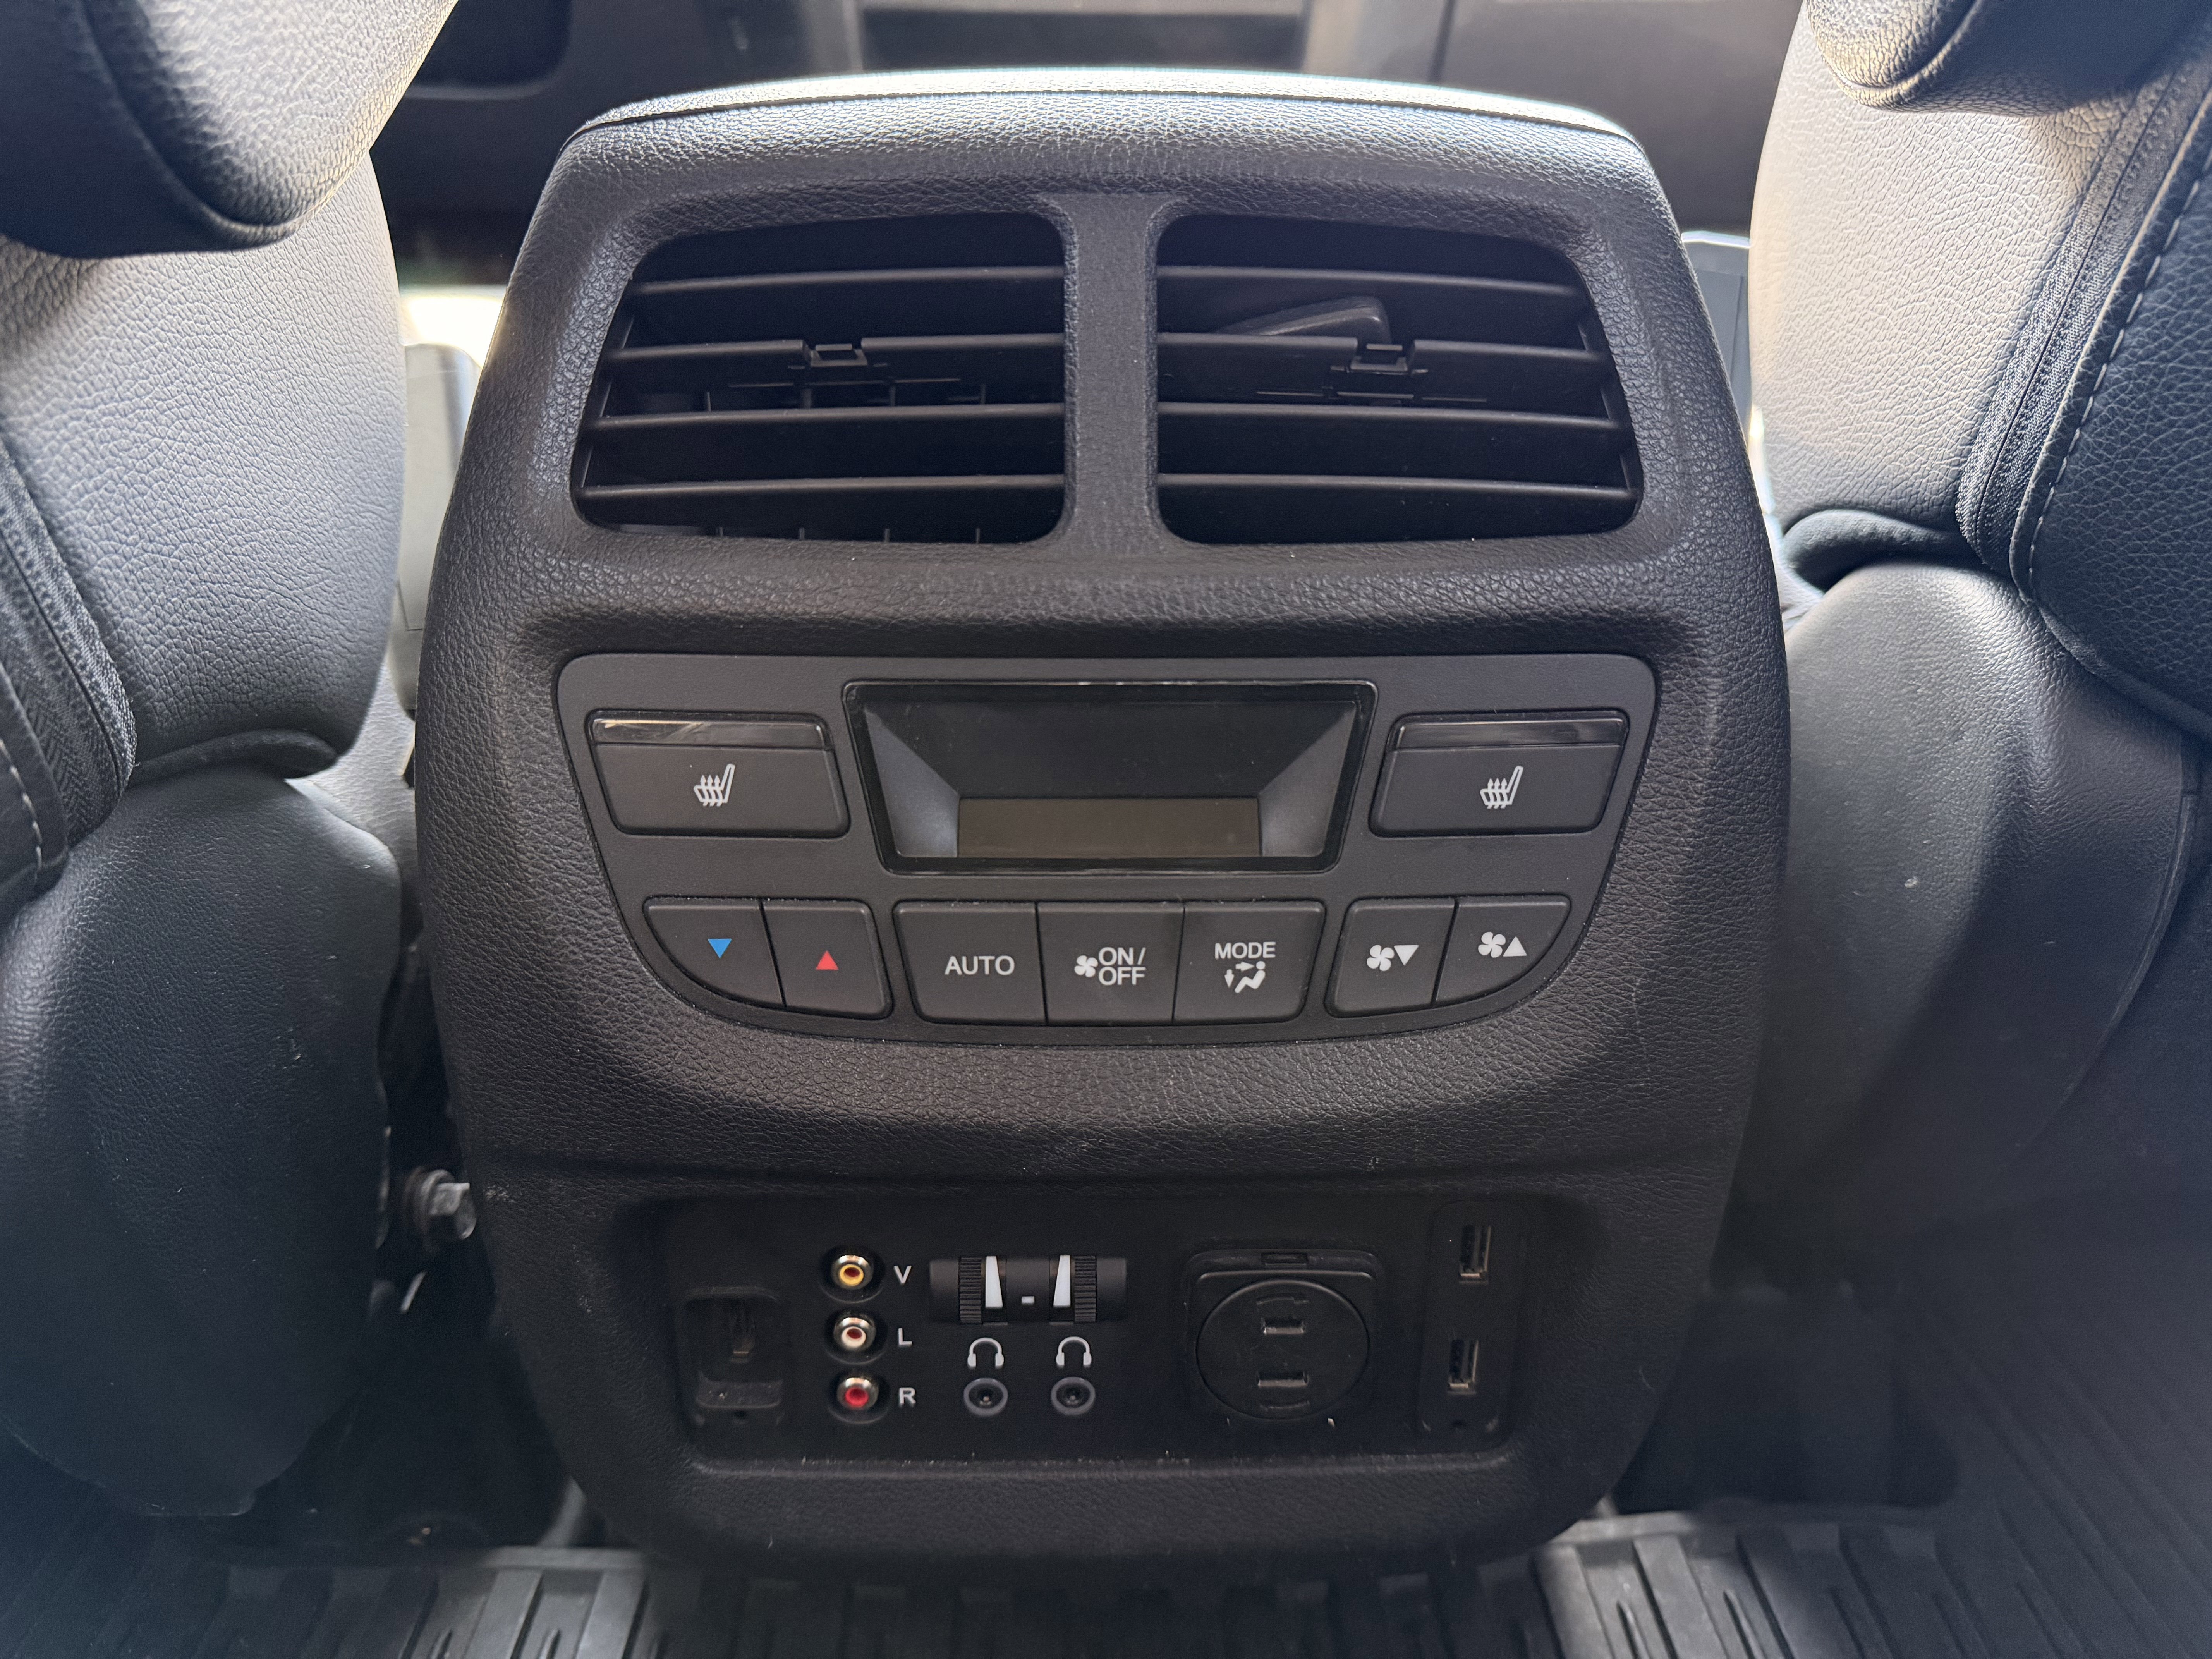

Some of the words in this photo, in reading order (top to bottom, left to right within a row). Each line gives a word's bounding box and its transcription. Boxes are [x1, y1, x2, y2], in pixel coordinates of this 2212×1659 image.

[1098, 946, 1146, 966] ON/
[1214, 941, 1276, 959] MODE
[945, 955, 1015, 975] AUTO
[1098, 966, 1147, 986] OFF
[893, 1265, 912, 1285] V
[898, 1328, 912, 1346] L
[898, 1387, 916, 1406] R
